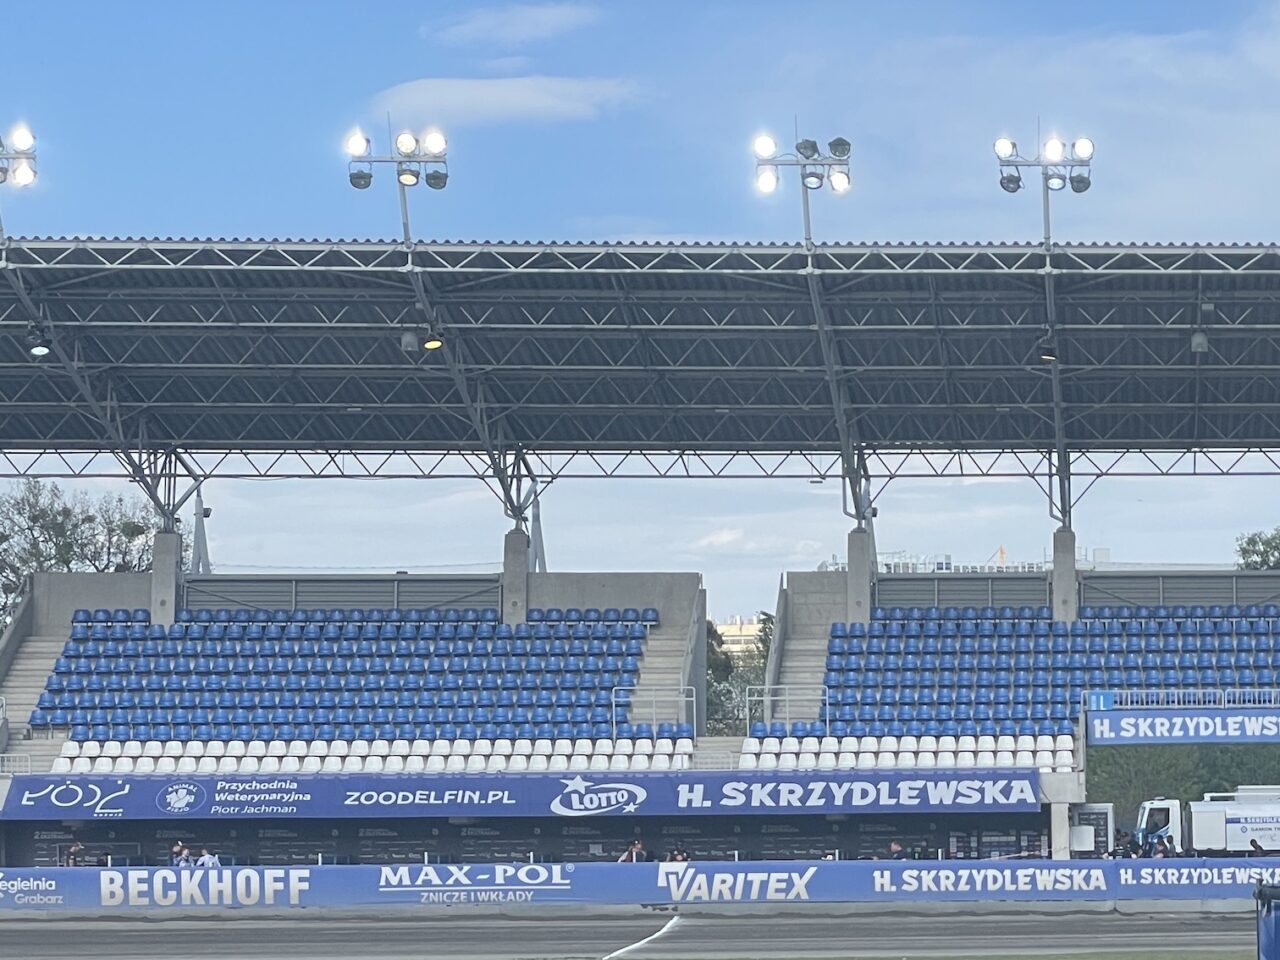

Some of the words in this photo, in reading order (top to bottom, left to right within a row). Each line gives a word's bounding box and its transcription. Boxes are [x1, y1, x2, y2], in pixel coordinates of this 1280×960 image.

[1093, 718, 1115, 738] H.
[216, 780, 298, 792] Przychodnia
[677, 783, 711, 808] H.
[720, 779, 1036, 807] SKRZYDLEWSKA
[214, 791, 311, 803] Weterynaryjna
[344, 790, 516, 805] ZOODELFIN.PL
[571, 789, 629, 810] LOTTO
[210, 804, 241, 814] Piotr
[241, 804, 297, 814] Jachman
[379, 865, 571, 886] MAX-POL
[657, 862, 818, 901] VARITEX
[873, 870, 896, 893] H.
[902, 867, 1106, 892] SKRZYDLEWSKA
[1120, 869, 1136, 885] H.
[0, 878, 56, 894] egielnia
[101, 869, 311, 906] BECKHOFF
[14, 893, 64, 904] Grabarz
[420, 891, 468, 903] ZNICZE
[476, 890, 534, 902] WKŁADY
